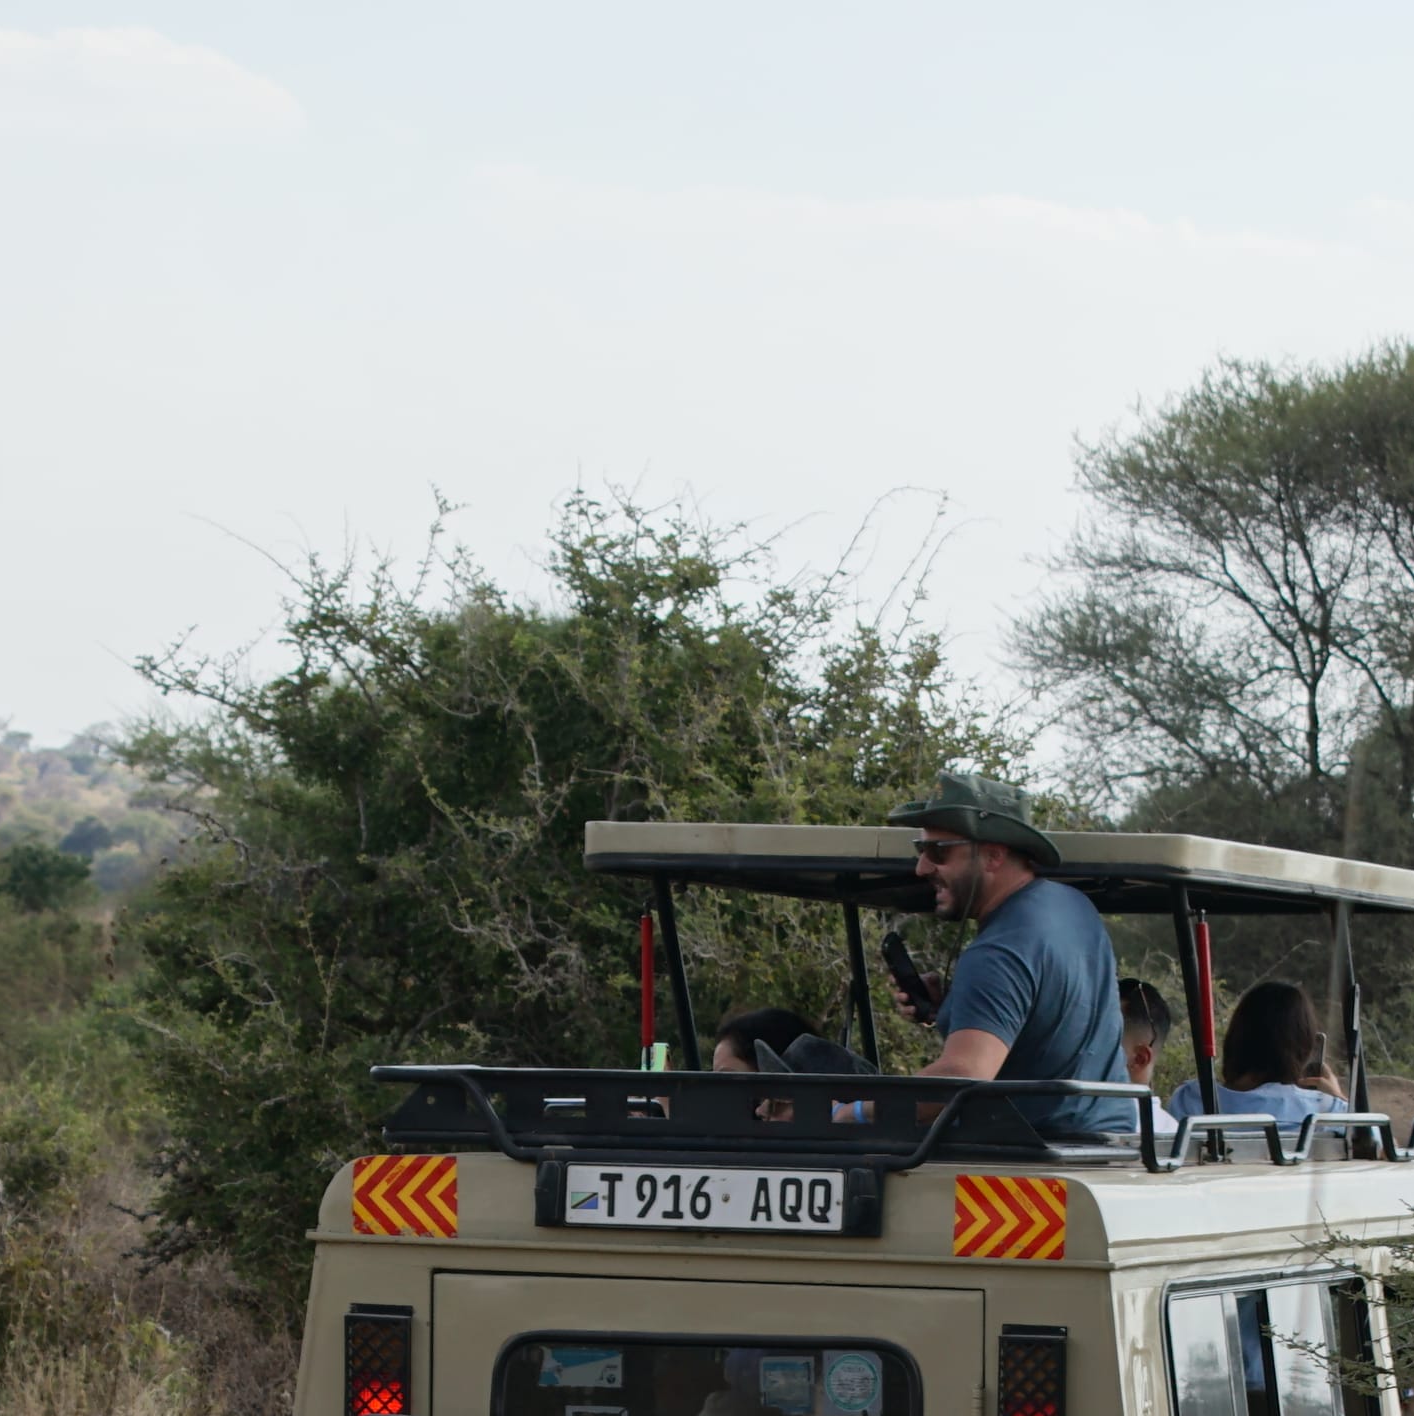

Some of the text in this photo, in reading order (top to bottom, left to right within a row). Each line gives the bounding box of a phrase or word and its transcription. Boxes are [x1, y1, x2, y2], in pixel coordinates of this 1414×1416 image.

[599, 1172, 833, 1223] T 916 AQQ
